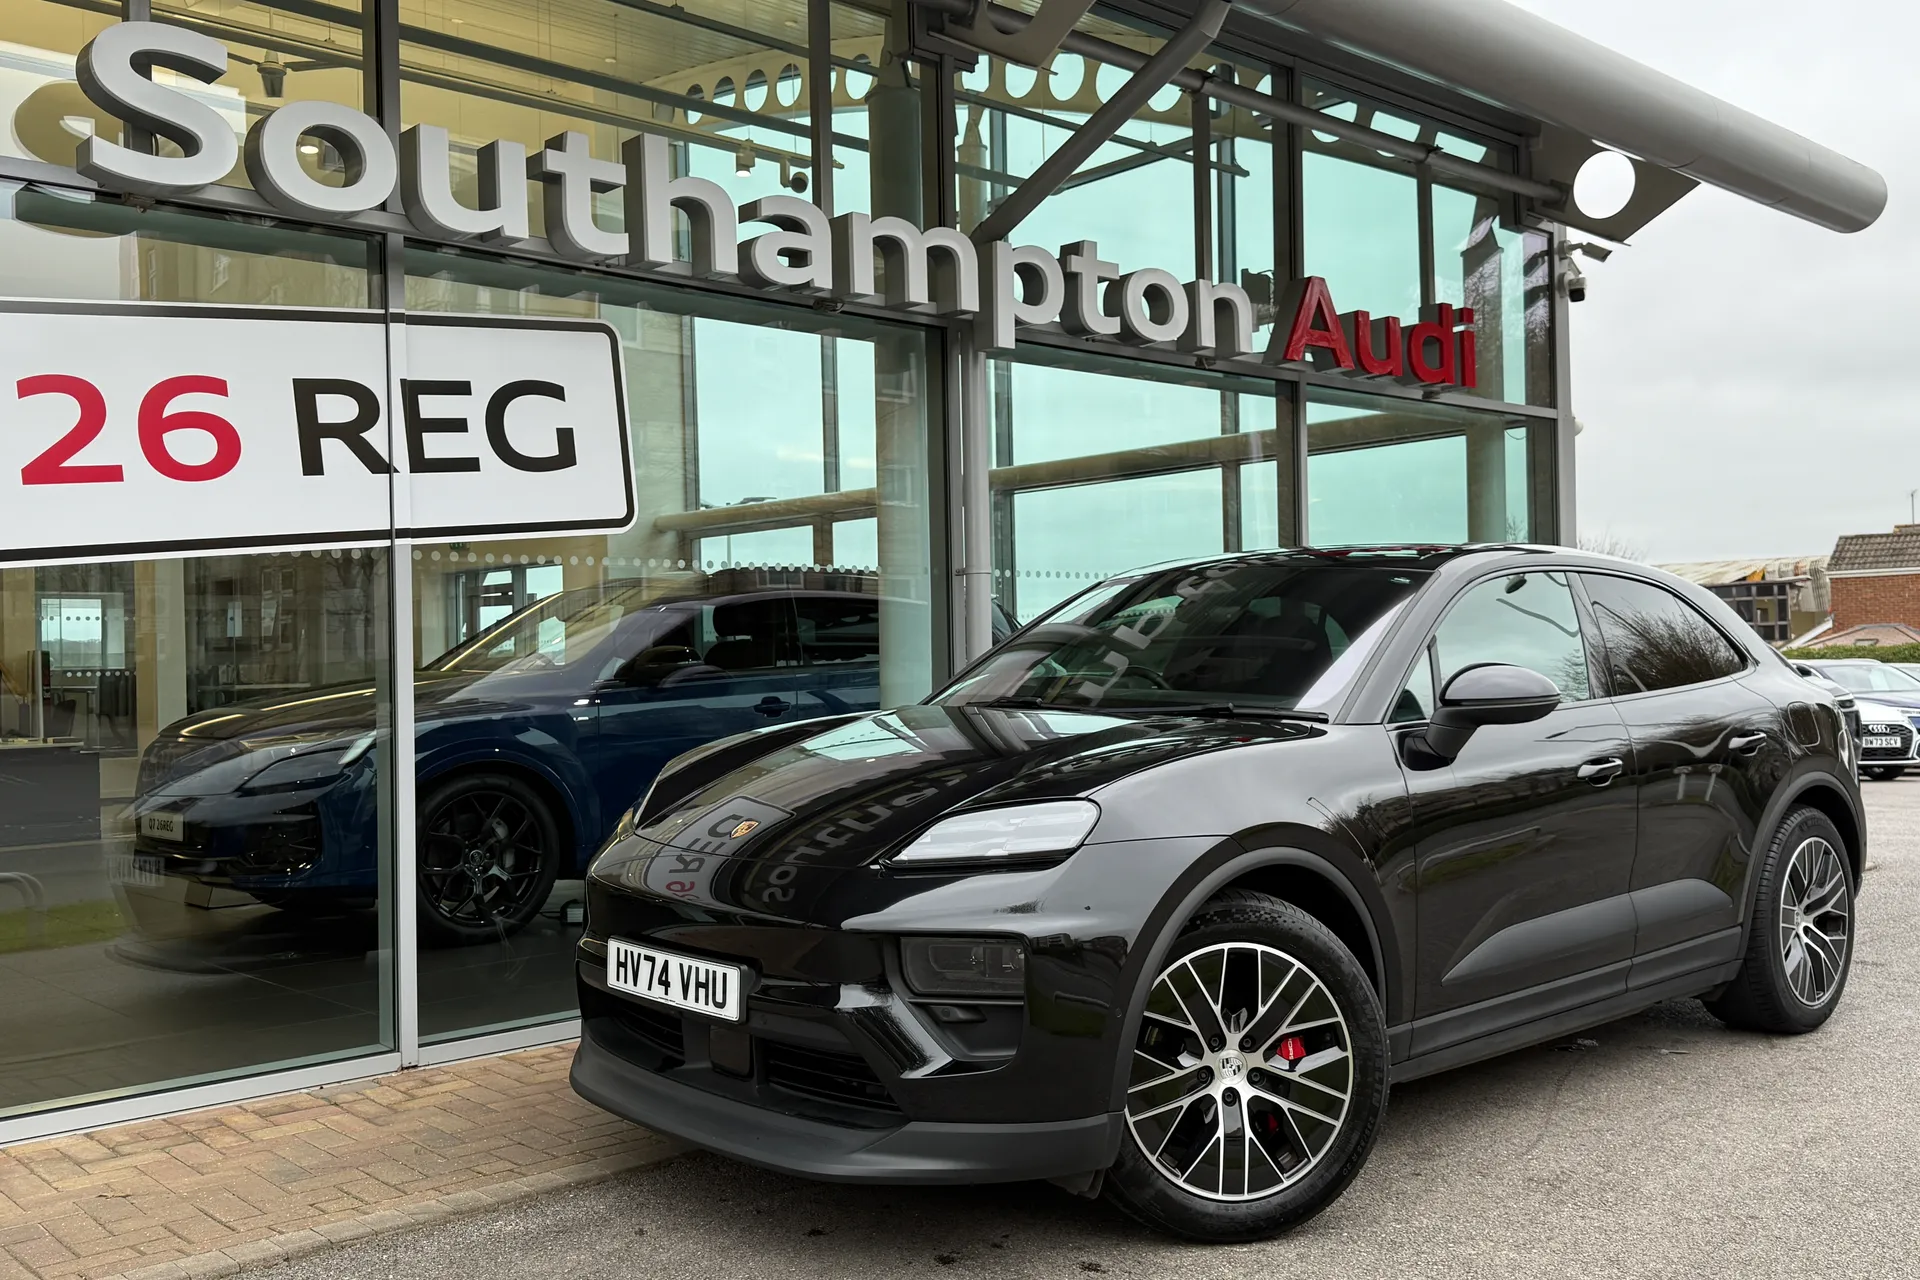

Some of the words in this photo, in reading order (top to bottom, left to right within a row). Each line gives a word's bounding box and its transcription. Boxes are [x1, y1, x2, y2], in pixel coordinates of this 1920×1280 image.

[77, 20, 1254, 350] Southampton
[1280, 275, 1478, 389] Audi
[16, 374, 242, 486] 26
[292, 378, 577, 476] REG
[616, 946, 671, 996] HV74
[679, 962, 727, 1010] VHU
